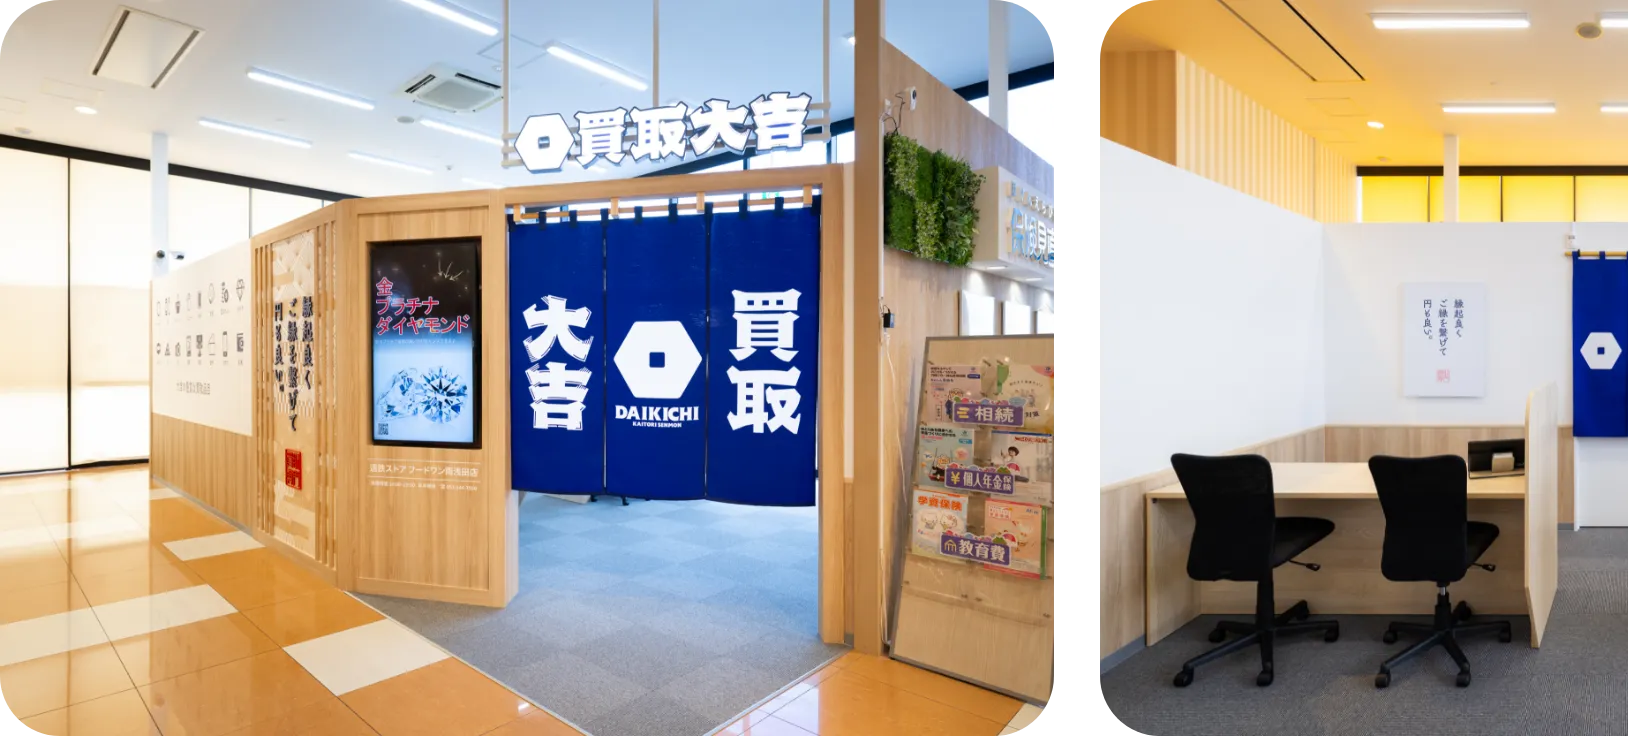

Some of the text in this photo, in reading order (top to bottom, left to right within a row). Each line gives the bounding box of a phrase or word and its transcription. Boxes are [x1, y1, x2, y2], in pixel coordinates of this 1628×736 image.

[573, 91, 812, 169] 買取大吉
[376, 276, 393, 296] 金
[376, 296, 439, 315] プラチナ
[376, 314, 470, 335] ダイヤモンド
[522, 294, 594, 431] 大吉
[726, 288, 802, 435] 買取
[615, 405, 700, 421] DAIKICHI
[975, 406, 1014, 423] 相続
[958, 539, 1005, 562] 教育費
